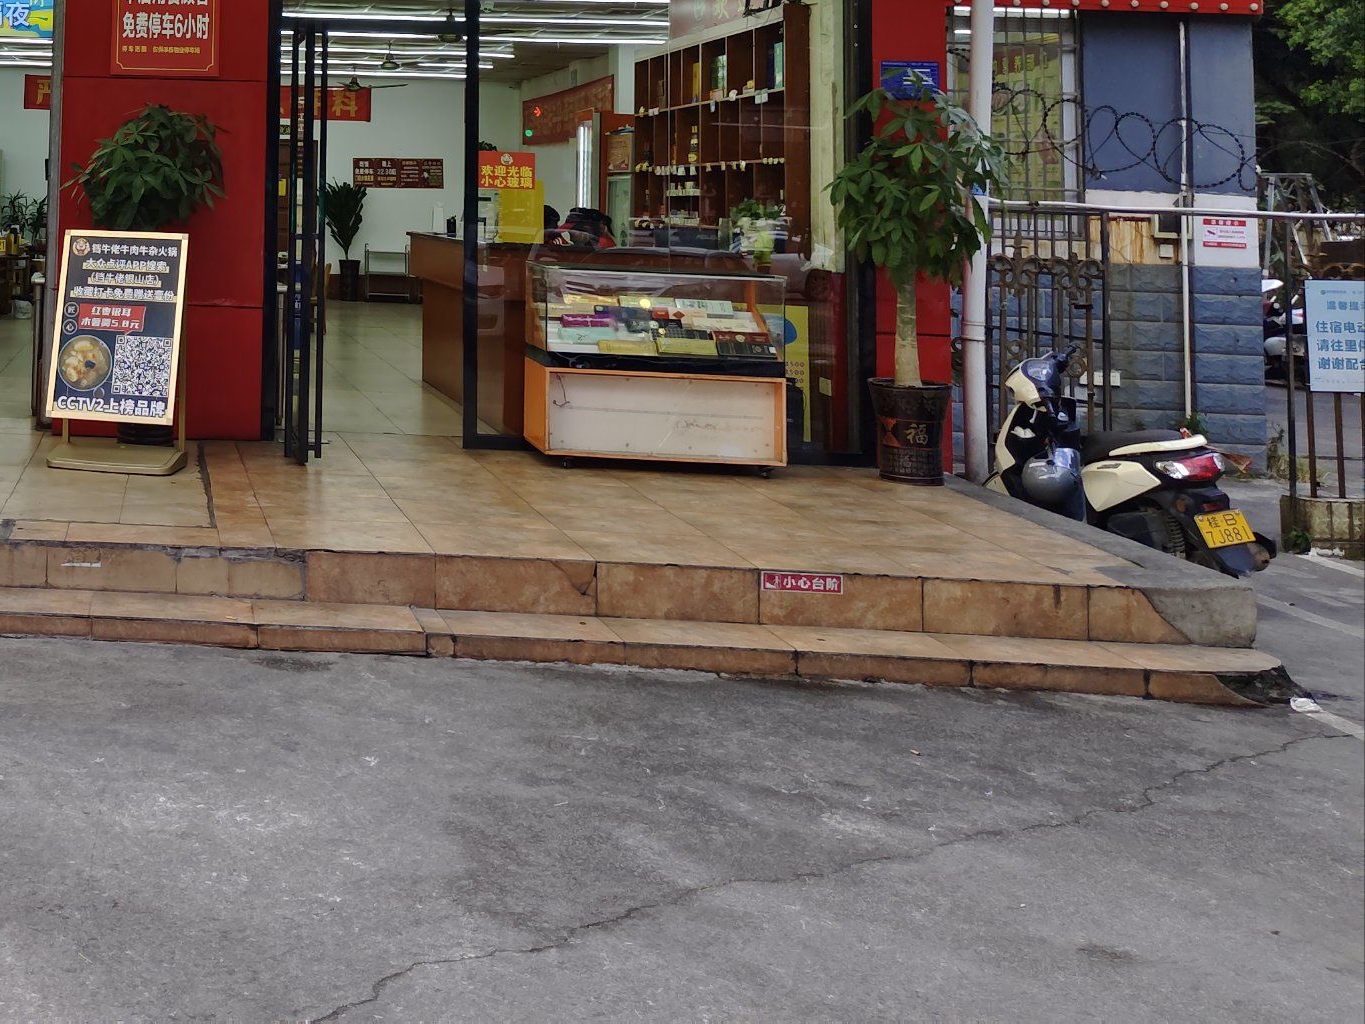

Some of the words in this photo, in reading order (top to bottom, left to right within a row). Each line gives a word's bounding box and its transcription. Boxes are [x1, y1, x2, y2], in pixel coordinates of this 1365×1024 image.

[122, 12, 210, 40] 免费停车6小时
[481, 165, 533, 177] 欢迎光临
[481, 176, 533, 188] 小心玻璃
[85, 257, 168, 272] 大众点评APP搜索
[904, 423, 929, 445] 福
[1206, 525, 1251, 545] 7J881
[783, 575, 839, 591] 小心台阶
